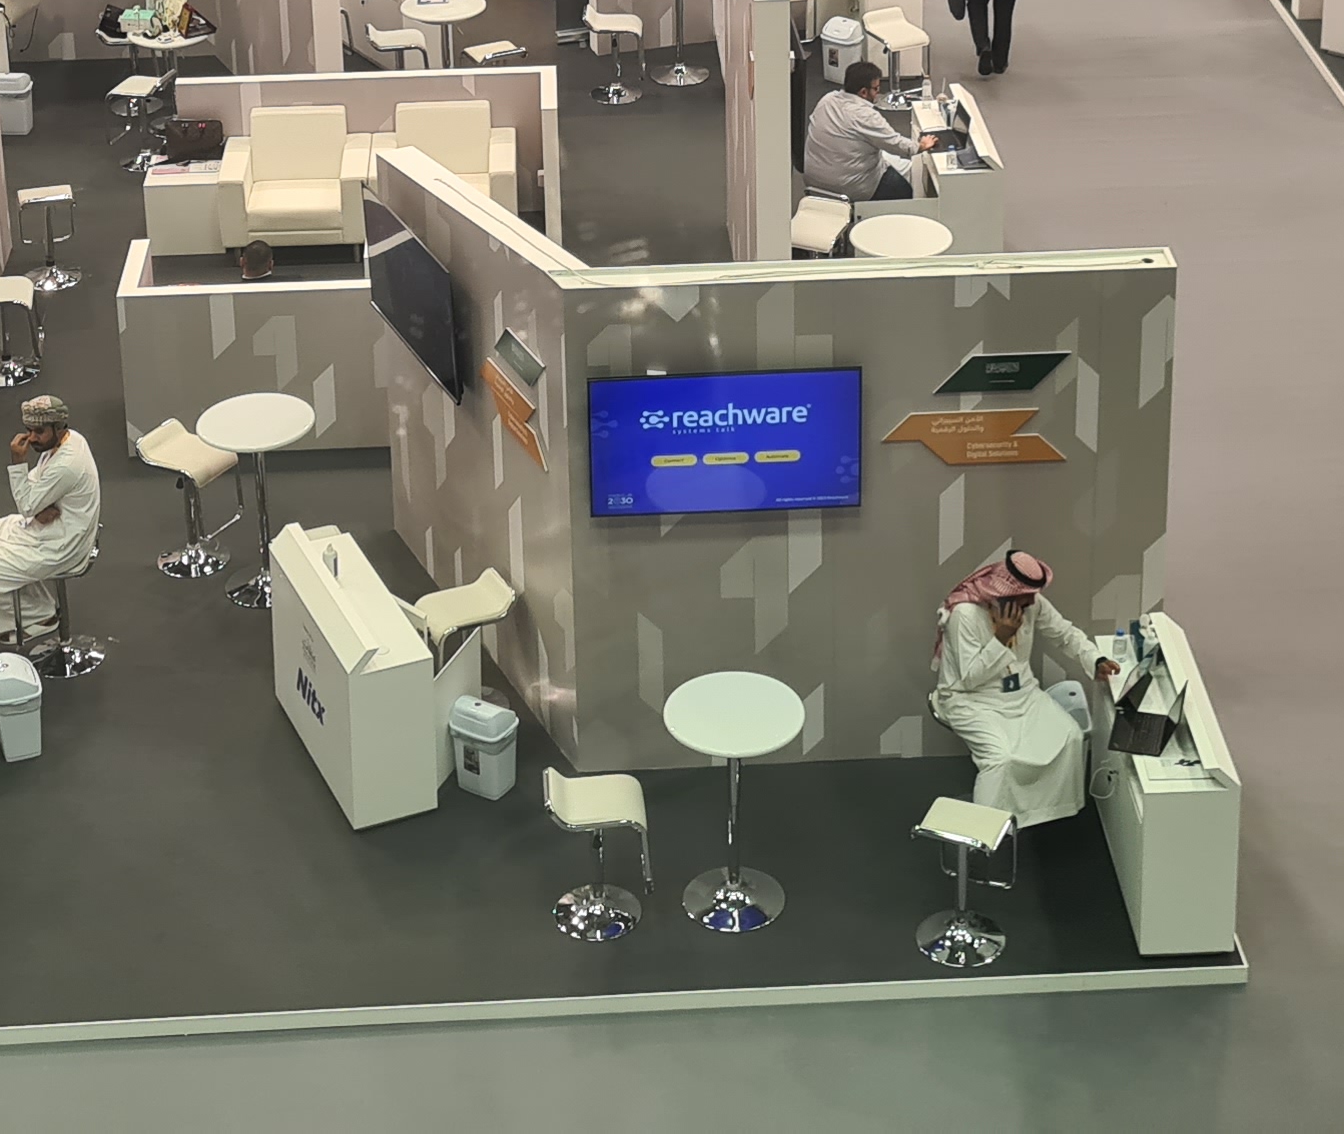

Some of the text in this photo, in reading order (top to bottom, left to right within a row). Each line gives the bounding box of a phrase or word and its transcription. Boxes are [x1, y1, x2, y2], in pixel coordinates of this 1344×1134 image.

[966, 441, 1012, 450] Cybersecurity
[966, 451, 987, 459] Digital
[297, 667, 325, 726] Nitx
